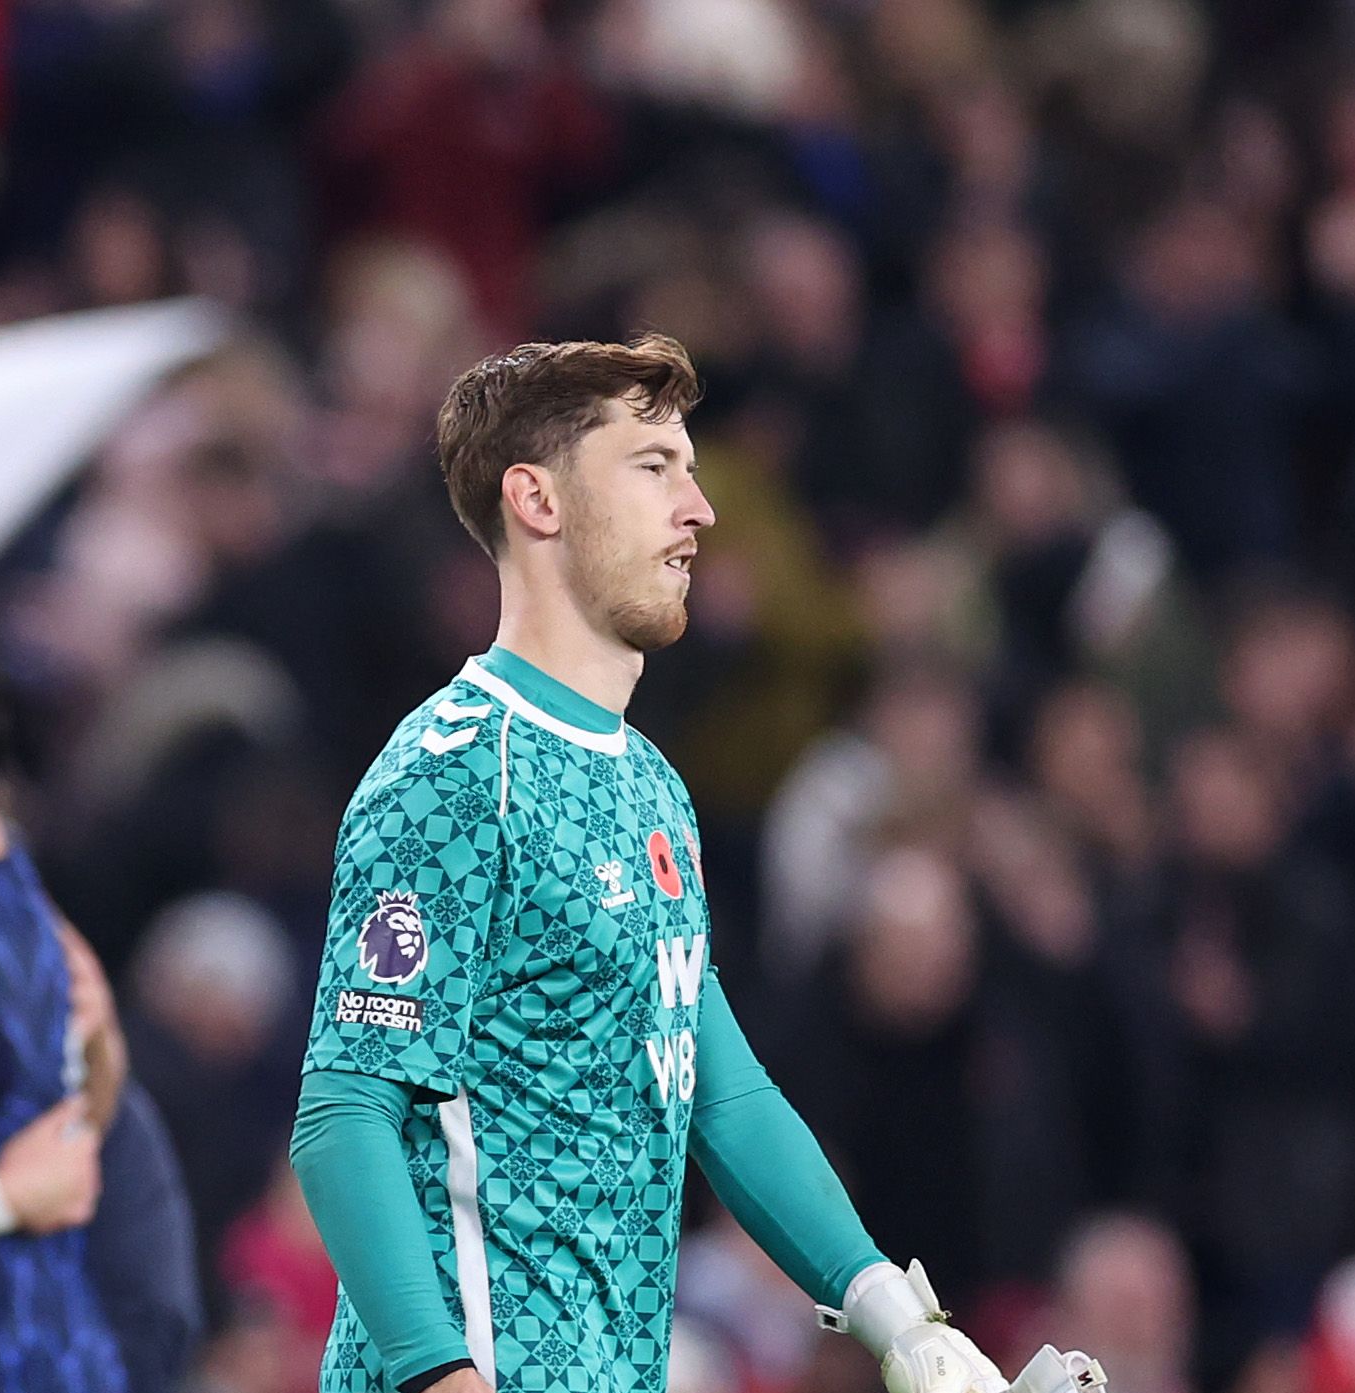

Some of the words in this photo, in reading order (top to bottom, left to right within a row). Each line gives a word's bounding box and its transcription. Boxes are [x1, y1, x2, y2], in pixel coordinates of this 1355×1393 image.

[657, 933, 706, 1009] W
[339, 991, 365, 1010] No
[366, 996, 416, 1016] room
[336, 1007, 363, 1022] for
[362, 1010, 422, 1033] racism
